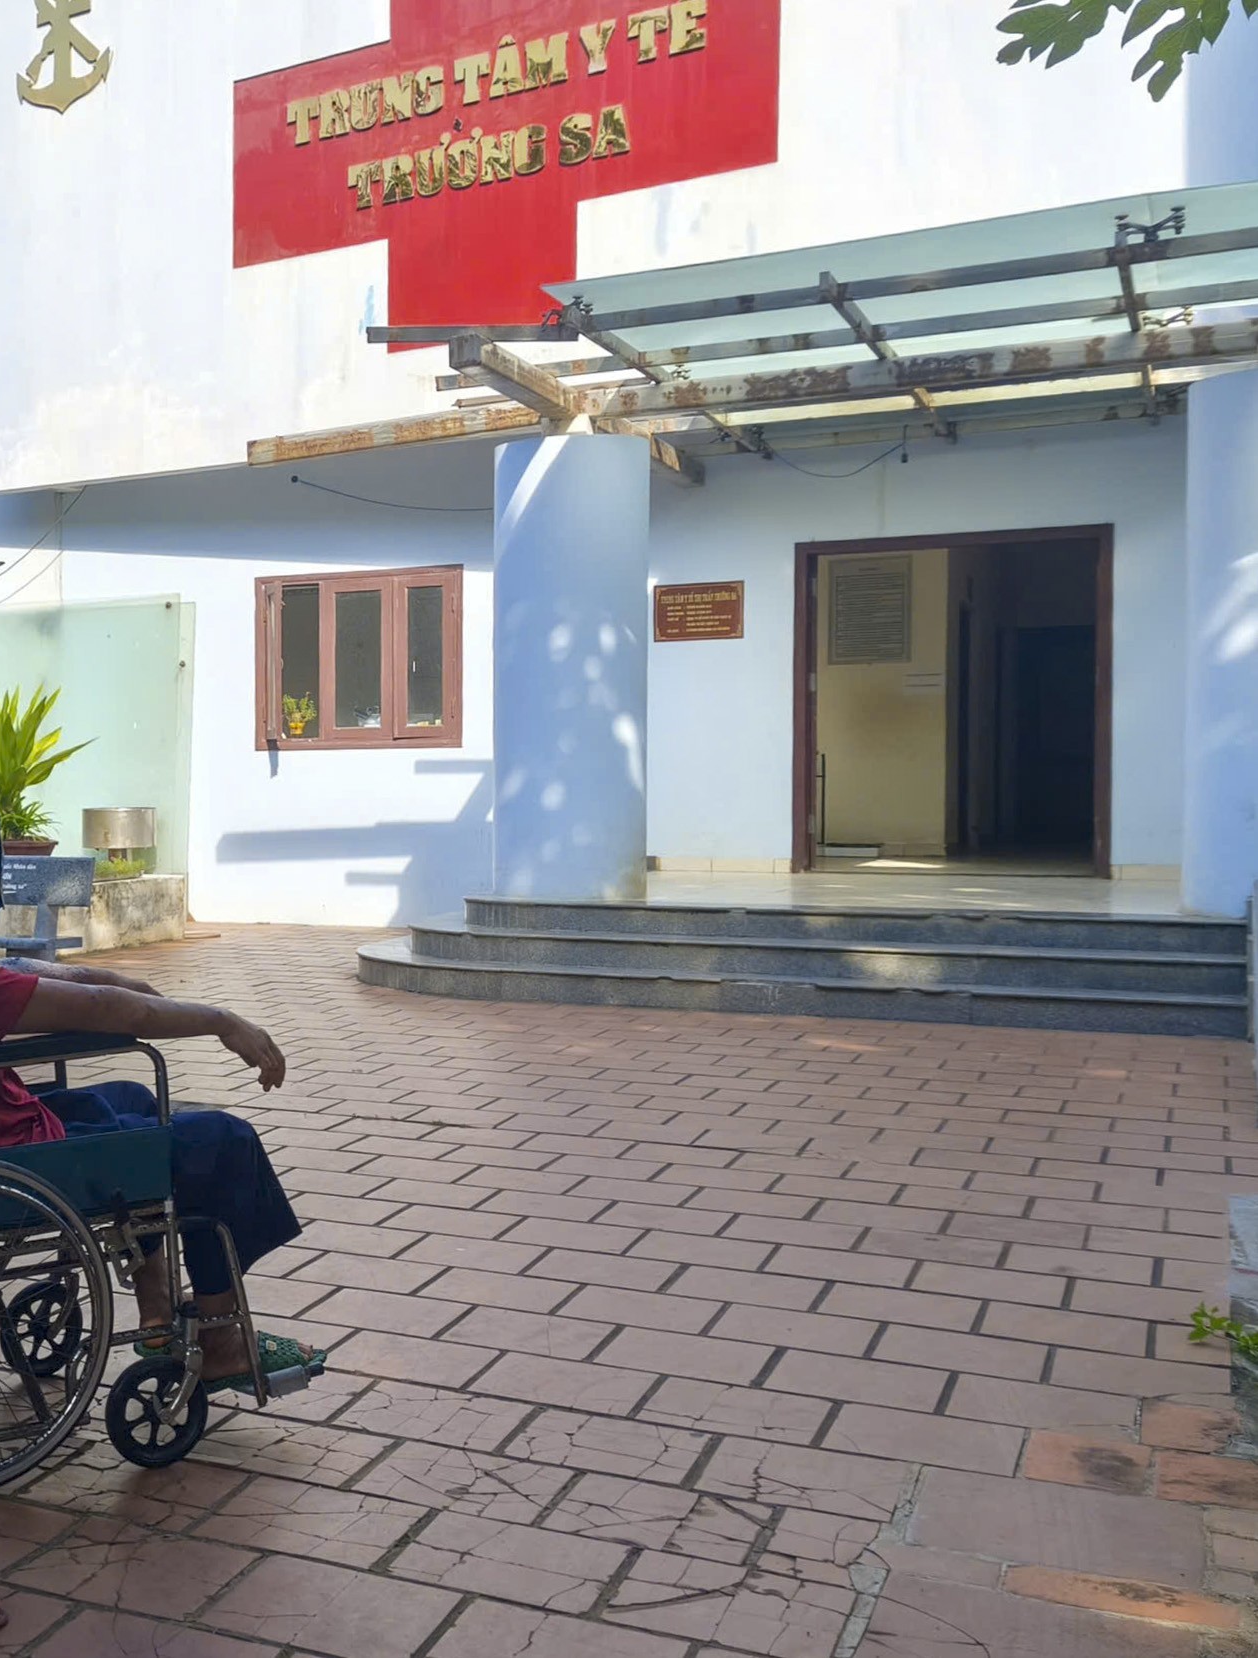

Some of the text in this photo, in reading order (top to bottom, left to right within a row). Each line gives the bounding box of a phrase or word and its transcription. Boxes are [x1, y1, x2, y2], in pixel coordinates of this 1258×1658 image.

[286, 65, 444, 145] TRUNG
[453, 33, 569, 106] TÂM
[579, 18, 617, 76] Y
[558, 104, 631, 166] SA
